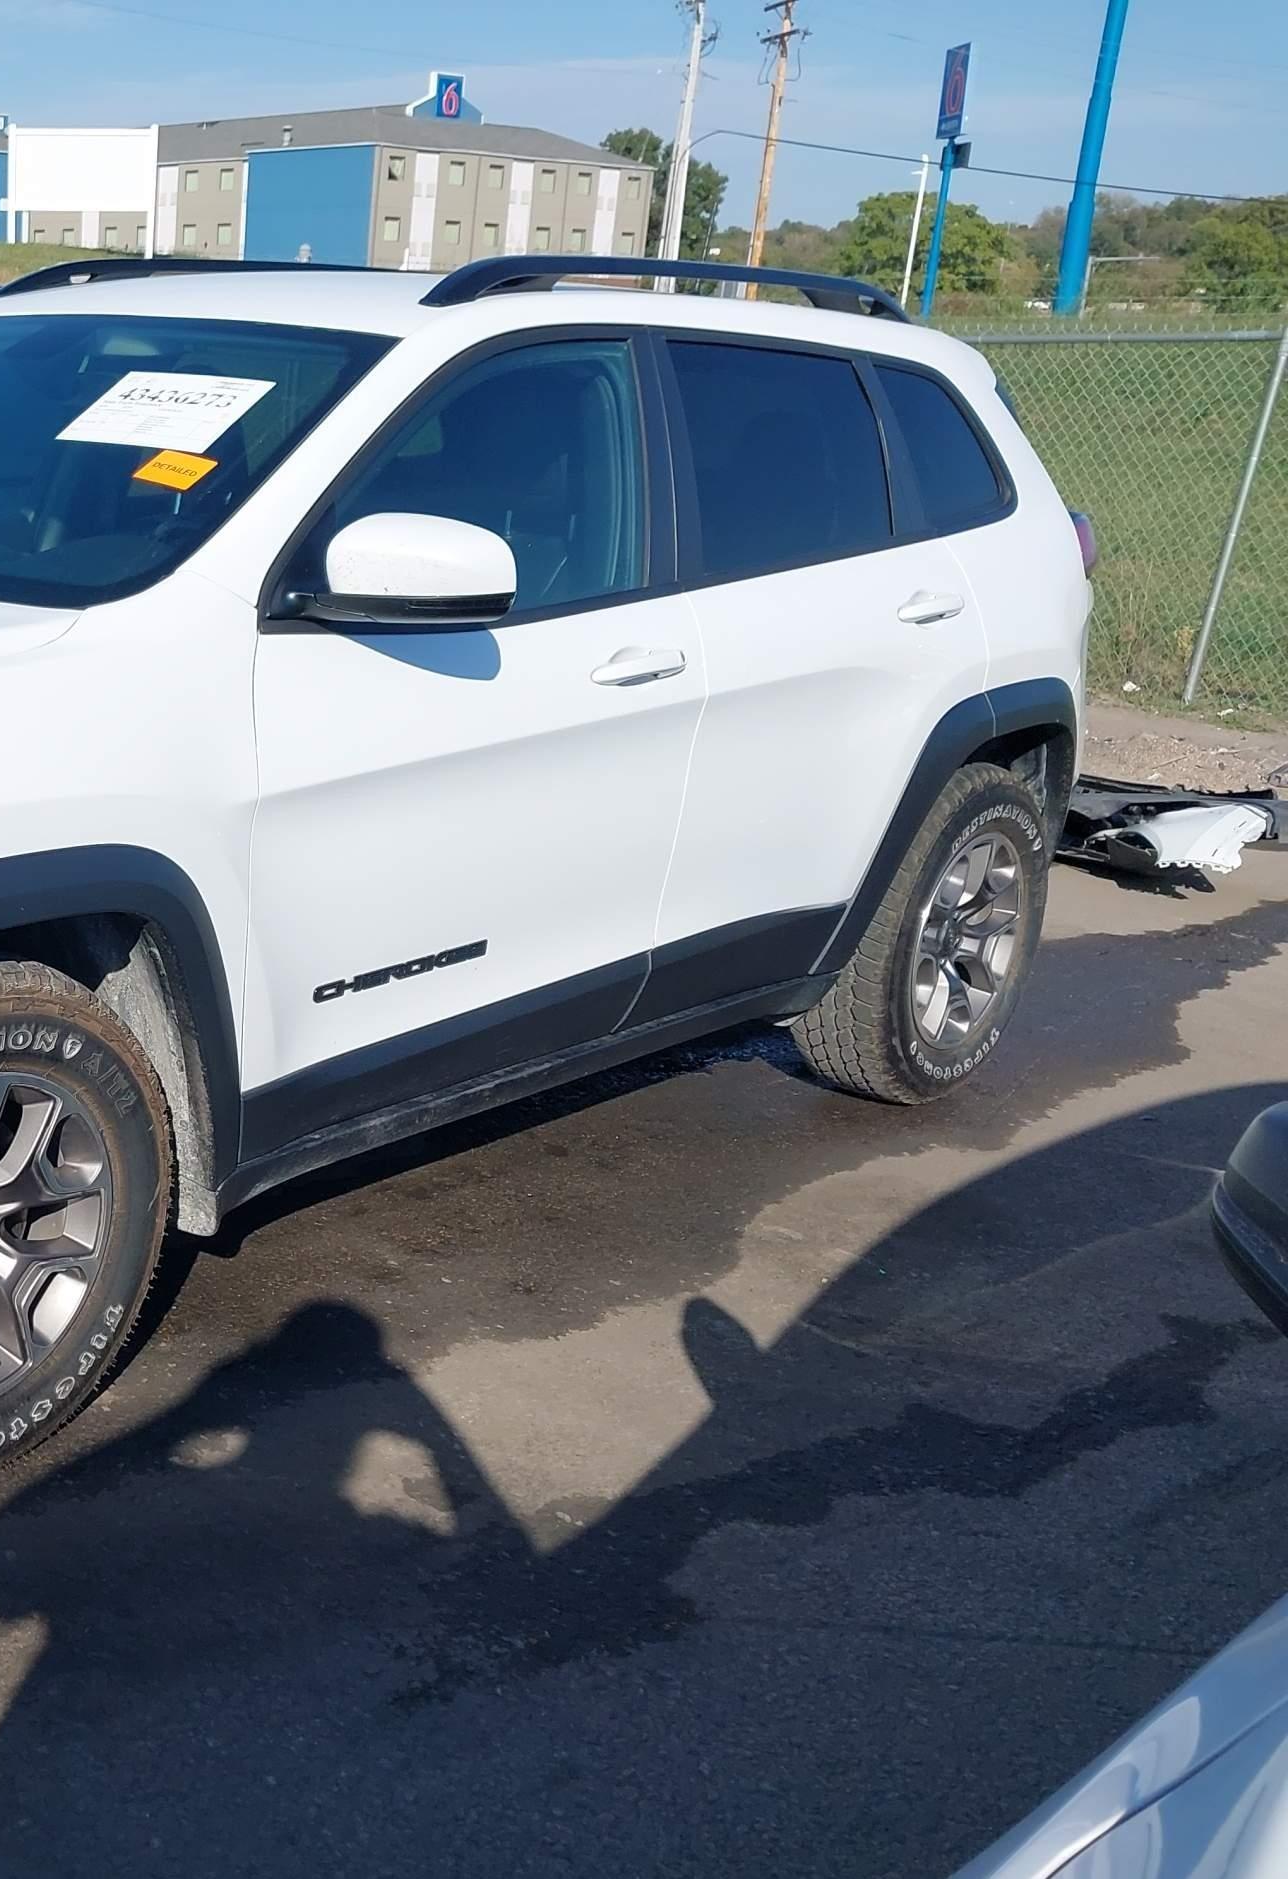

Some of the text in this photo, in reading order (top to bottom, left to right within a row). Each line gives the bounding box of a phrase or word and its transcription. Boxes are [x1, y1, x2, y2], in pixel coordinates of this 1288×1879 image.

[443, 82, 459, 116] 6
[119, 386, 238, 409] 43436273
[152, 461, 199, 478] DETAILED
[952, 804, 1039, 854] DESTINATION
[312, 938, 489, 1005] CHEROKEE
